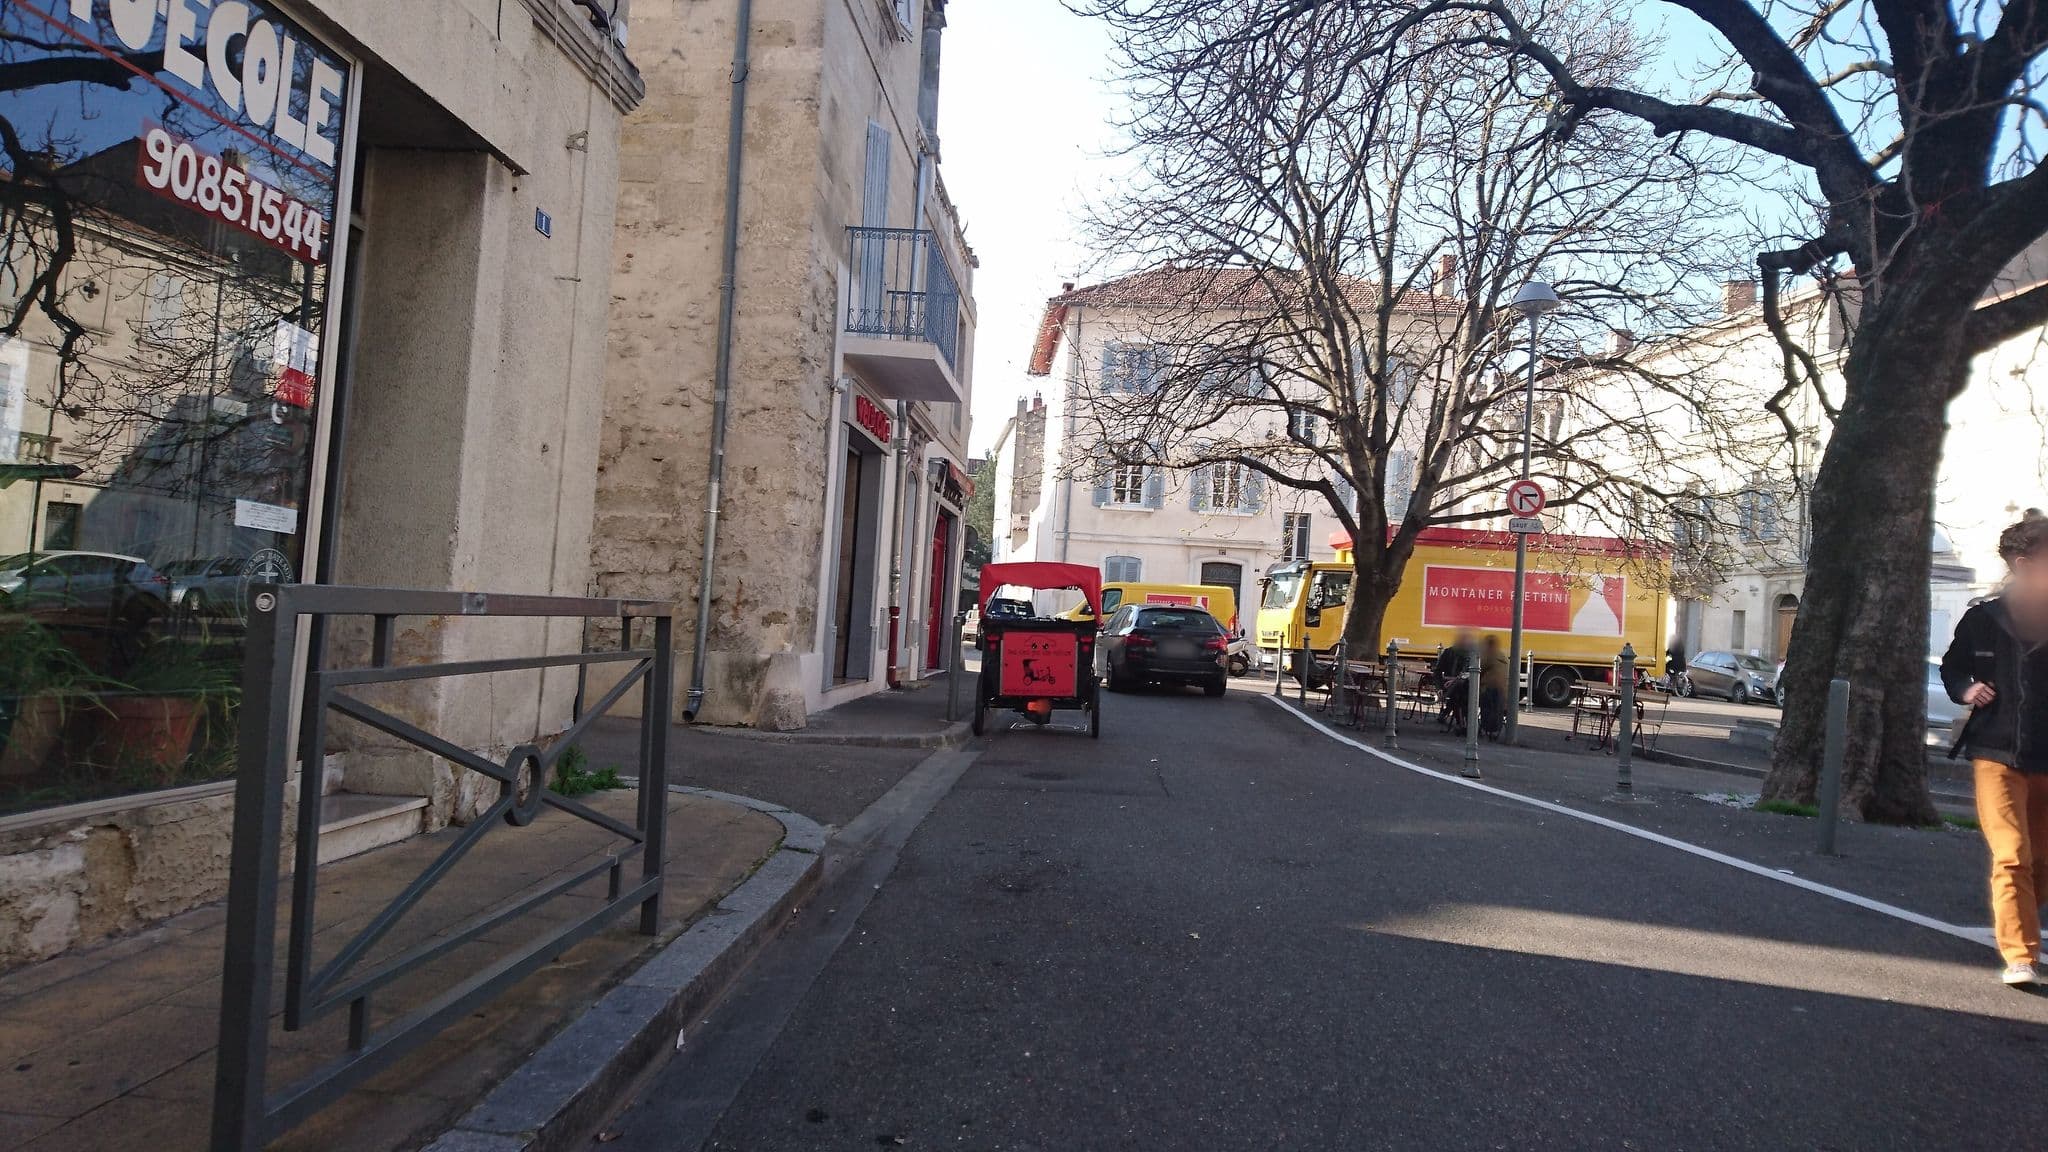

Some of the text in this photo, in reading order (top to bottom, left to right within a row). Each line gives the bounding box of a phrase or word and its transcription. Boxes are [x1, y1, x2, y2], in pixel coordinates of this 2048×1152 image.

[141, 127, 323, 262] 90.85.15.44
[1429, 586, 1569, 604] MONTANER PETRINI
